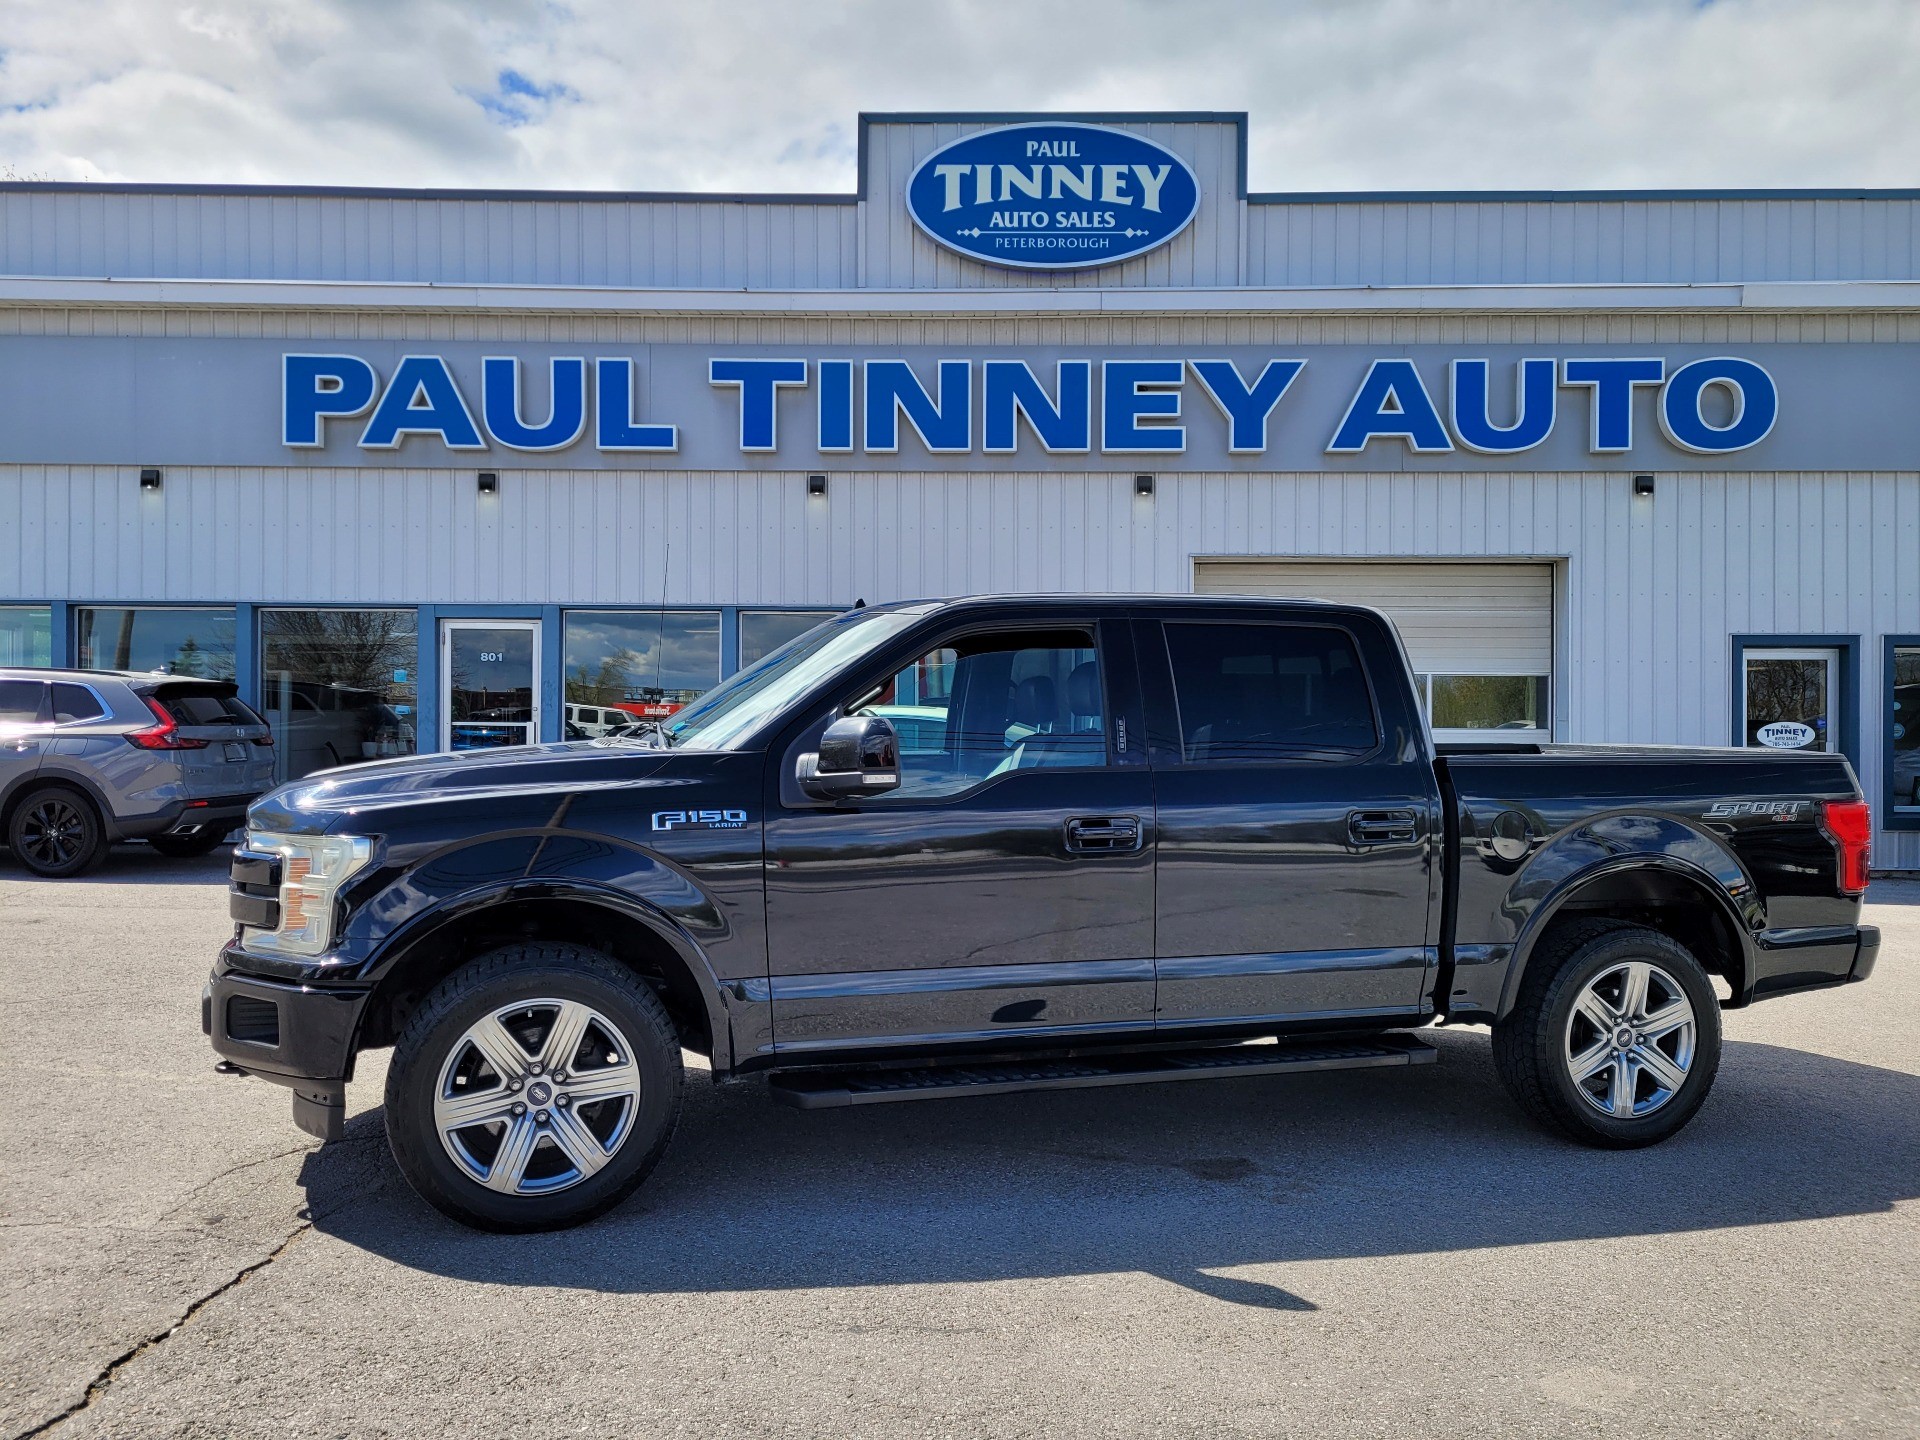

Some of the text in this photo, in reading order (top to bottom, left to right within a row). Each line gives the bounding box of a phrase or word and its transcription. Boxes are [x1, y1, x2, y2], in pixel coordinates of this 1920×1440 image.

[1026, 140, 1081, 158] PAUL
[933, 164, 1173, 214] TINNEY
[989, 211, 1116, 229] AUTO SALES
[995, 237, 1110, 249] PETERBOROUGH
[281, 352, 1780, 456] PAUL TINNEY AUTO
[480, 652, 503, 662] 801
[1764, 728, 1808, 739] TINNEY
[1701, 800, 1811, 819] SPORT
